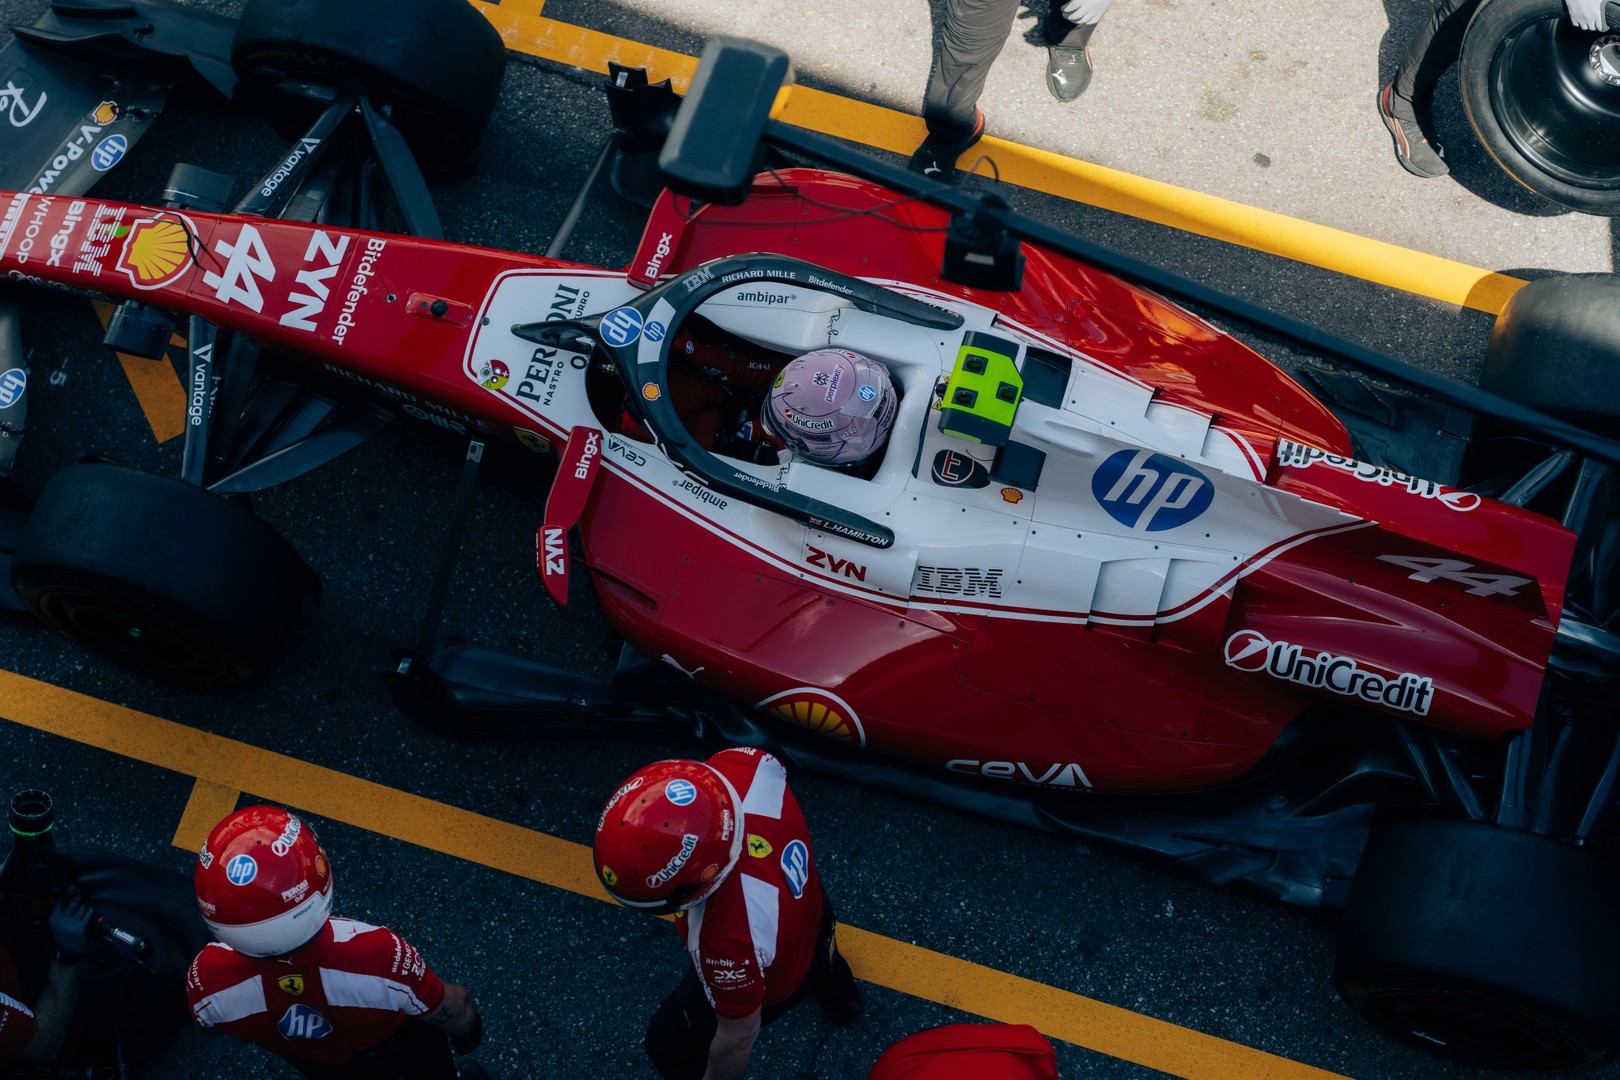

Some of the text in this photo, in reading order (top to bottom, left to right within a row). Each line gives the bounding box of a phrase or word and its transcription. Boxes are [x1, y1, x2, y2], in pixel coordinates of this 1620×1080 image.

[29, 125, 102, 194] V-Pow
[261, 149, 305, 197] vantage
[16, 197, 56, 264] WHOOP
[72, 204, 127, 276] IBM
[203, 223, 276, 314] 44
[279, 230, 350, 332] ZYN
[682, 267, 715, 293] IBM
[721, 270, 796, 283] RICHARD MILLE
[808, 275, 853, 296] Bitdefender
[331, 238, 387, 345] Bitdefender
[601, 312, 642, 344] hp
[189, 363, 206, 426] vantage
[543, 361, 564, 406] NASTRO
[825, 364, 845, 403] perplexity
[792, 415, 834, 430] UniCredit
[734, 472, 780, 493] Bitdefender
[1103, 449, 1205, 531] hp
[544, 528, 565, 576] ZYN
[822, 520, 889, 546] L.HAMILTON
[806, 546, 867, 582] ZYN
[917, 565, 1003, 598] IBM
[1375, 554, 1533, 597] 44
[1269, 642, 1432, 714] UniCredit
[721, 809, 730, 841] PERONI
[228, 856, 255, 884] hp
[657, 833, 698, 882] UniCredit
[281, 880, 309, 901] PERONI
[713, 968, 746, 980] DXC
[287, 1010, 325, 1039] hp
